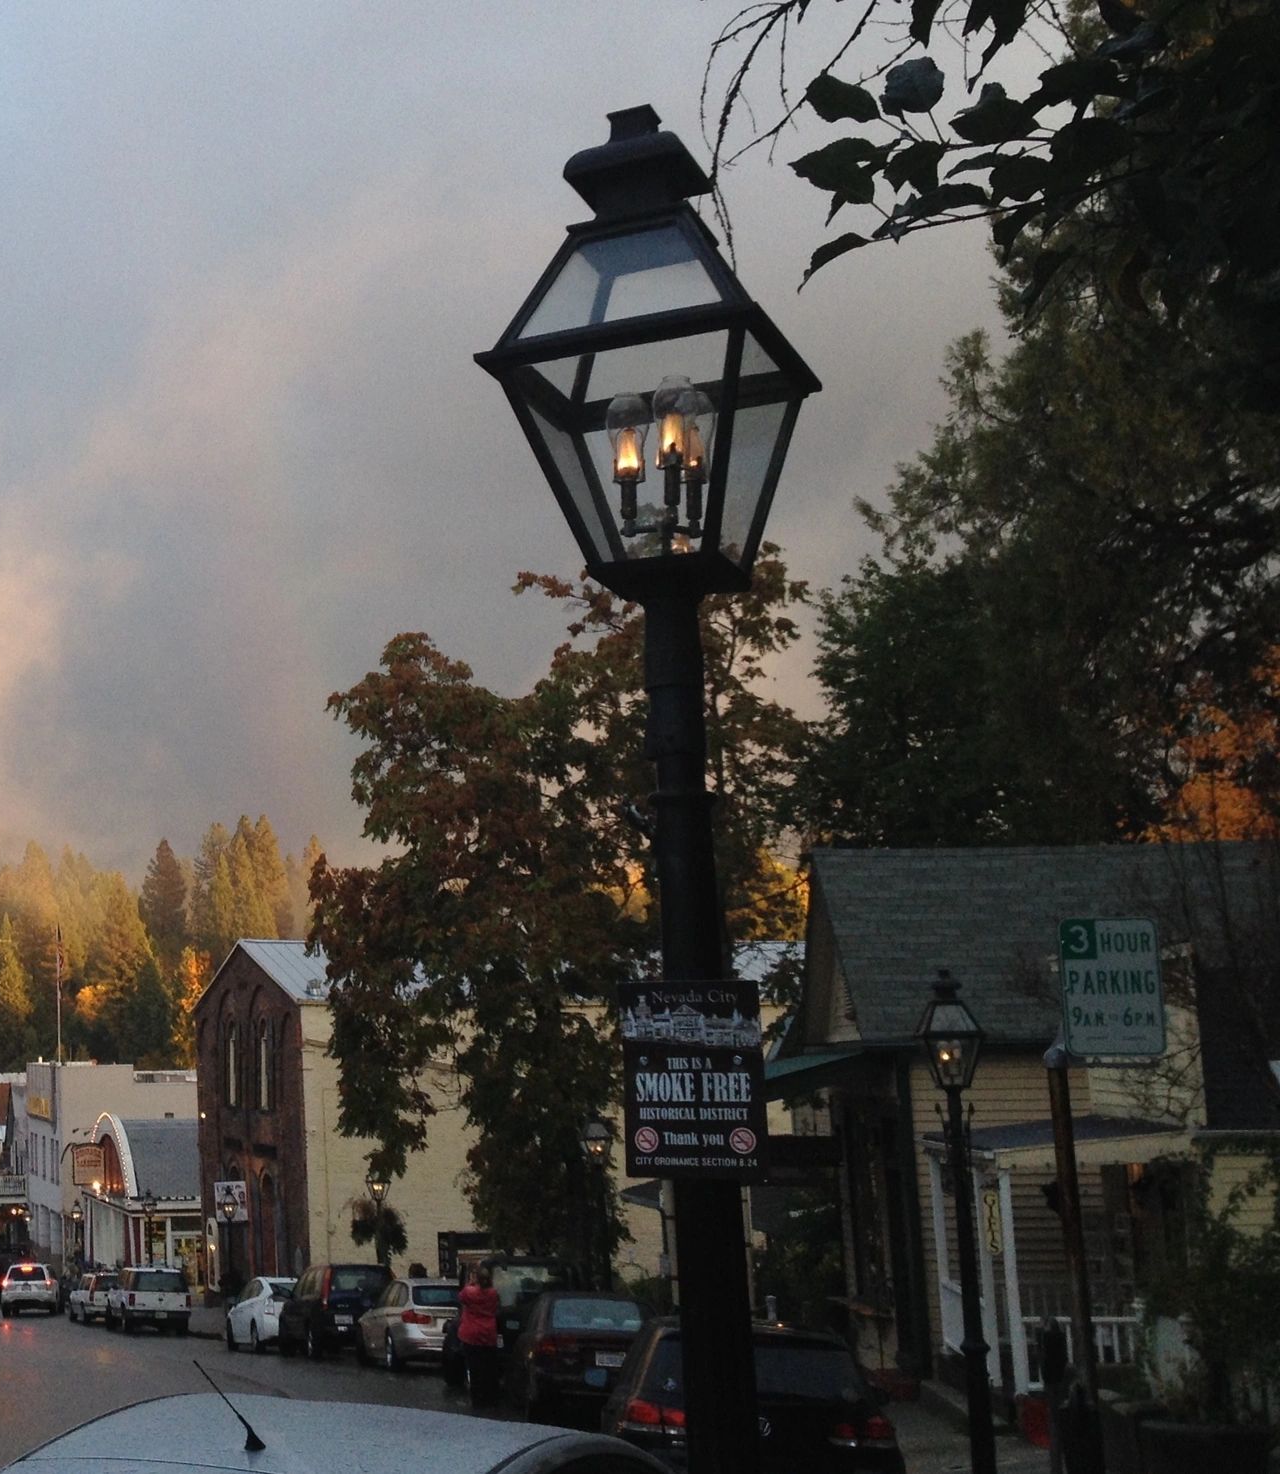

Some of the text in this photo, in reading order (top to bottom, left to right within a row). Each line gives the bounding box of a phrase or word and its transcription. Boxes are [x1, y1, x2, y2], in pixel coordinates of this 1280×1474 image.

[1069, 925, 1151, 954] 3 HOUR
[1068, 970, 1156, 995] PARKING
[652, 989, 738, 1005] Nevada City
[667, 1057, 712, 1069] THIS IS A
[635, 1072, 752, 1102] SMOKE FREE
[639, 1107, 749, 1121] HISTORICAL DISTRICT
[663, 1131, 724, 1148] Thank you
[635, 1156, 652, 1165] CITY
[654, 1156, 699, 1167] ORDINANCE
[701, 1157, 737, 1168] SECTION
[983, 1193, 999, 1253] GIFTS
